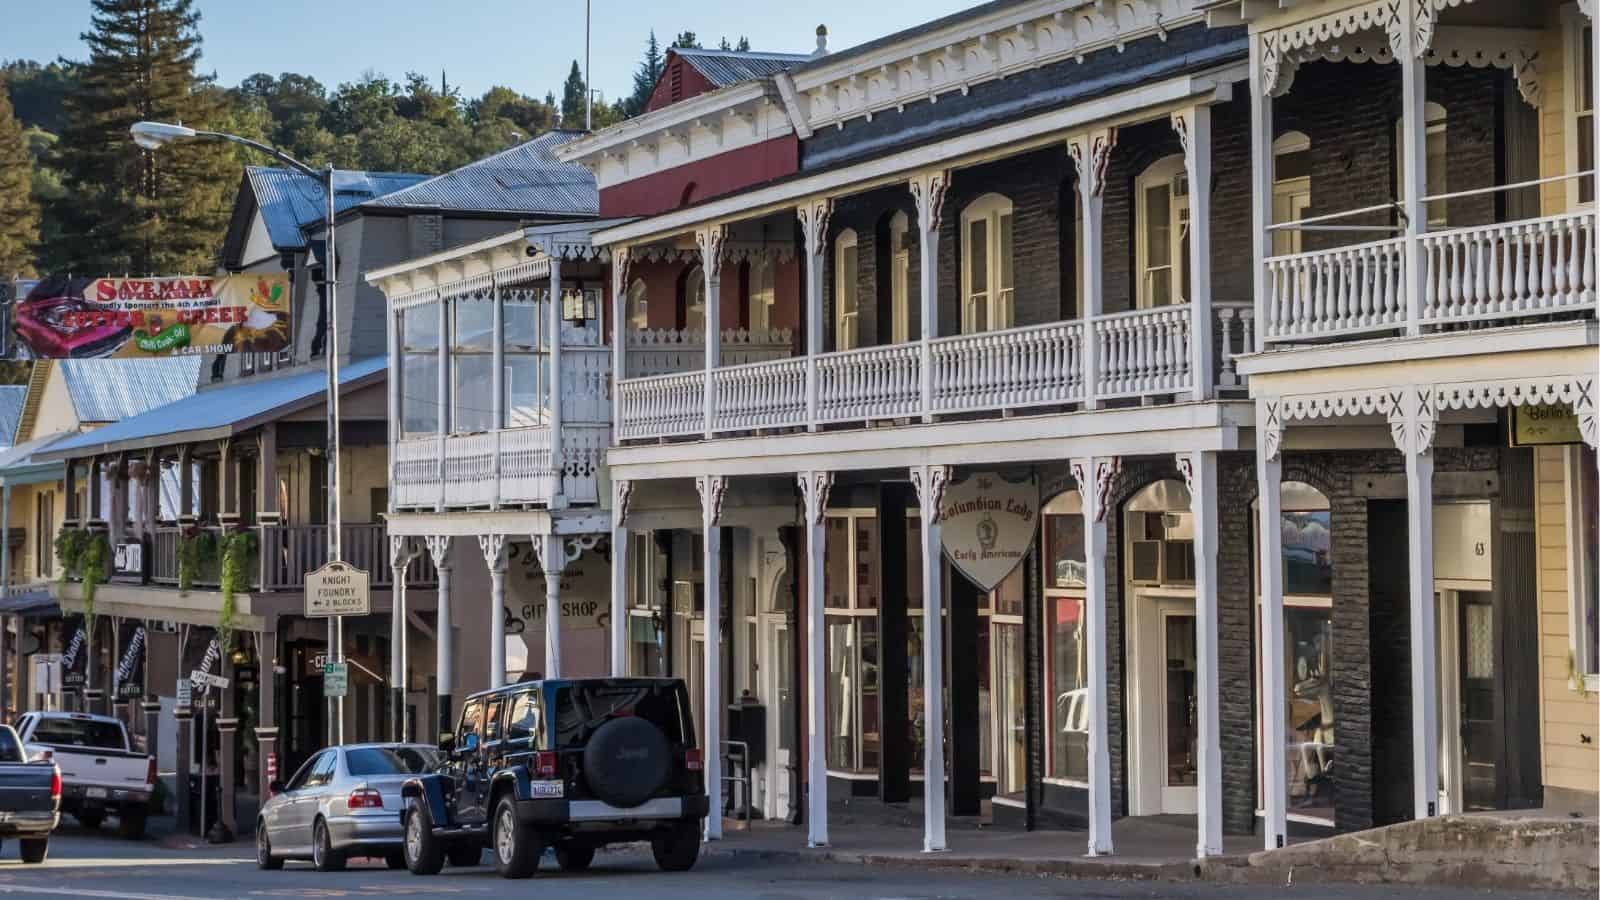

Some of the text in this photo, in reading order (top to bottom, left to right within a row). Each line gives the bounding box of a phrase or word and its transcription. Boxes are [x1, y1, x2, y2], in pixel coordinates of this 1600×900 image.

[177, 301, 190, 309] 4th
[176, 306, 248, 325] CREEK
[205, 343, 233, 353] SHOW
[322, 575, 352, 585] KNIGHT
[317, 587, 356, 598] FOUNDRY
[325, 598, 363, 607] 2 BLOCKS
[562, 601, 598, 618] SHOP
[119, 626, 145, 681] Welcome
